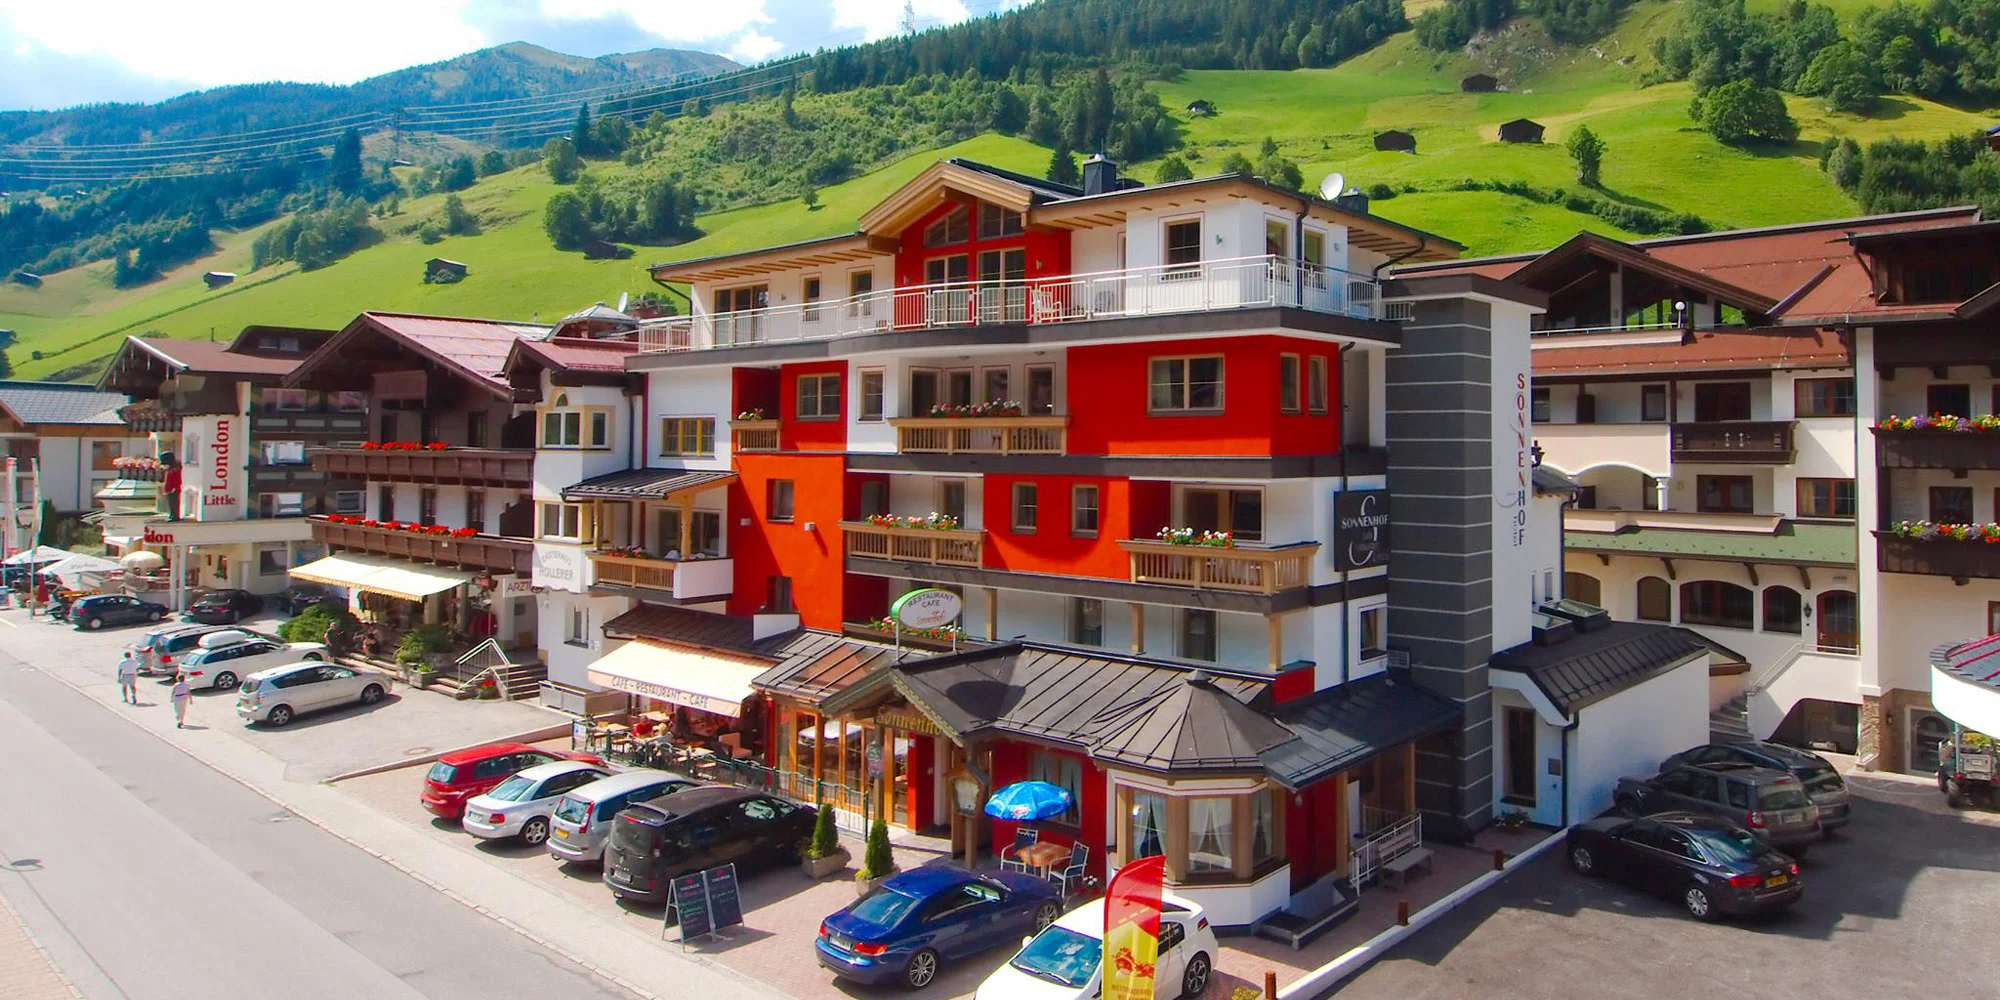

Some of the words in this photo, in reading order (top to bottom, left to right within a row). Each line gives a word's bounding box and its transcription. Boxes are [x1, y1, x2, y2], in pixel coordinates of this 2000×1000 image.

[210, 420, 229, 491] London
[1517, 373, 1525, 545] SONNENHOF
[203, 494, 236, 506] Little
[1342, 514, 1389, 529] SONNENHOF
[907, 592, 955, 608] RESTAURANT
[922, 600, 941, 608] CAFE
[636, 682, 681, 703] RESTAURANT
